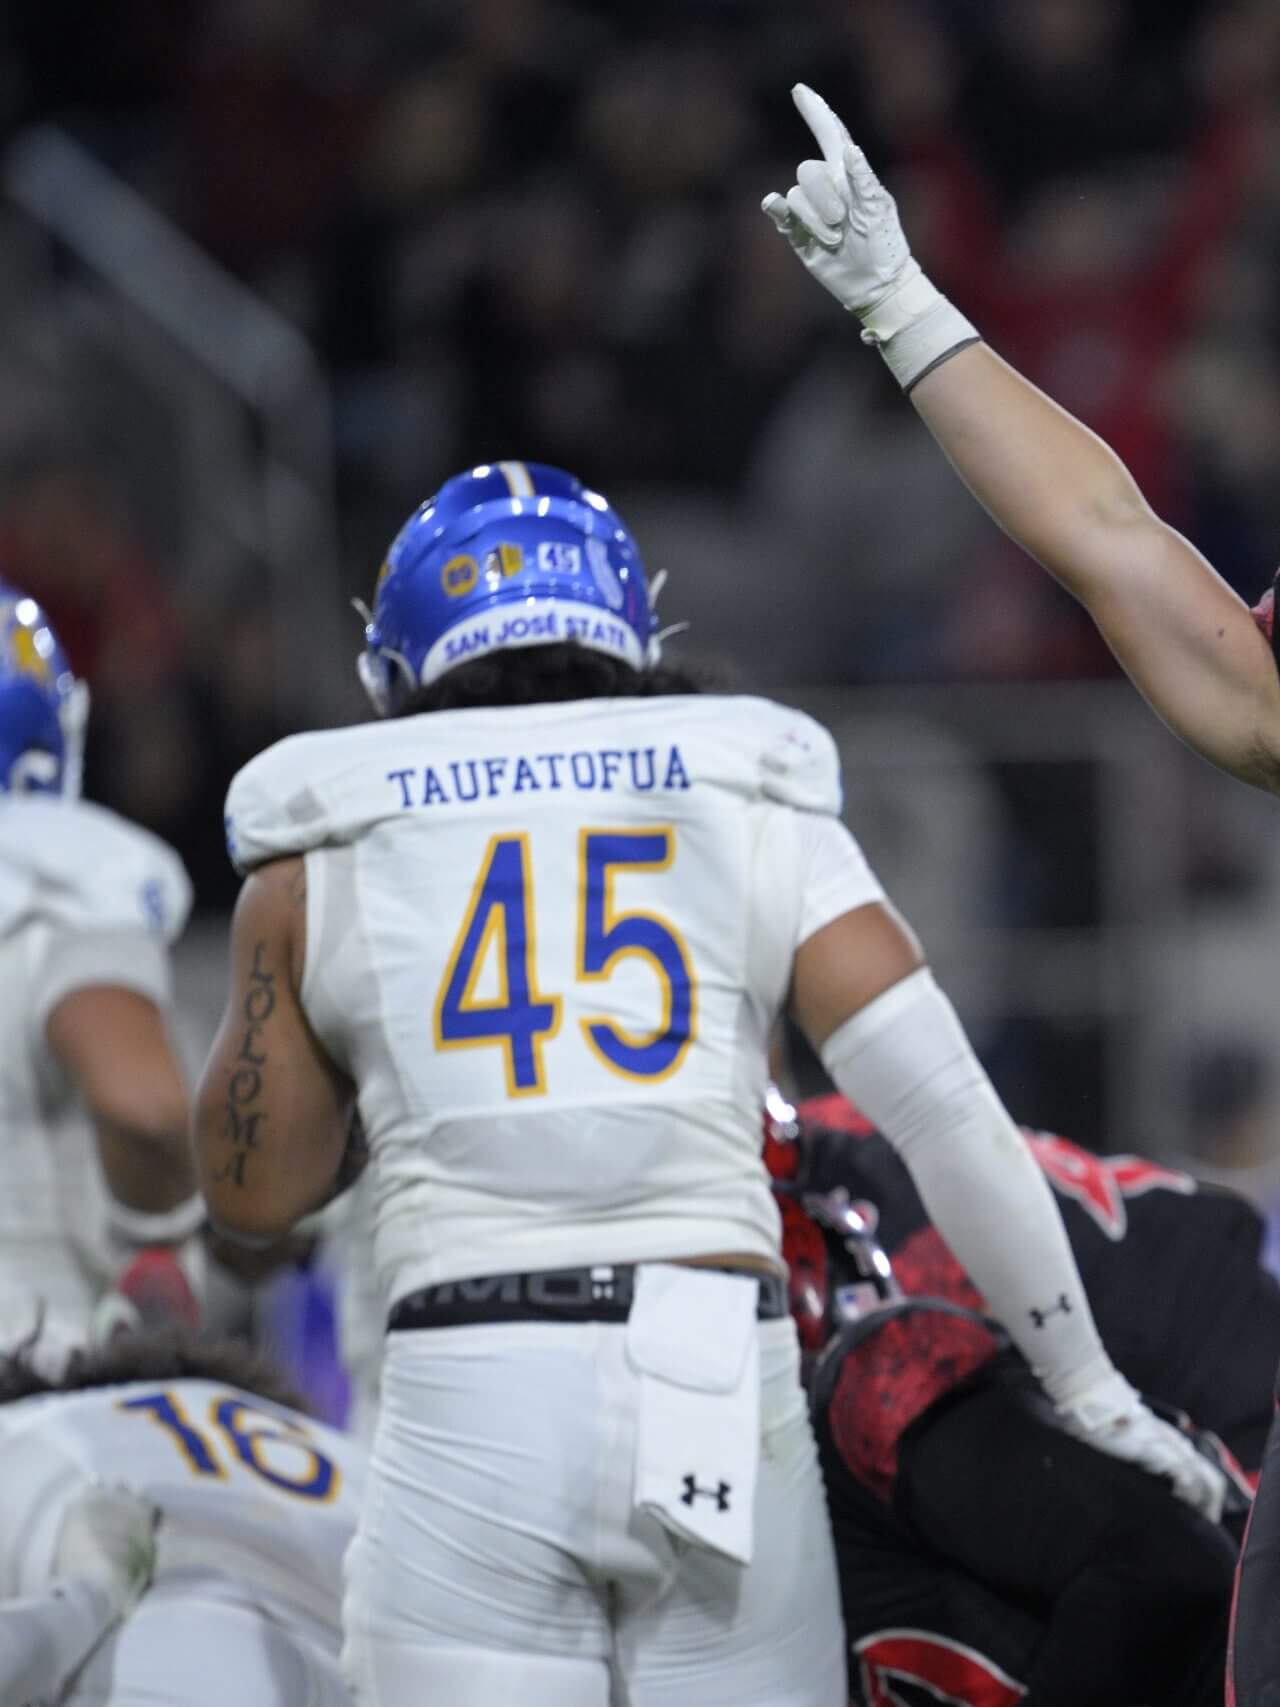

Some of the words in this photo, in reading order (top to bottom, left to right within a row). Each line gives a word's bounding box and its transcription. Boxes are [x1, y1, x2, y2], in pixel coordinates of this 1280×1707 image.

[444, 623, 490, 662] SAN
[495, 611, 559, 643] JOSÉ
[565, 615, 626, 651] STATE
[386, 744, 692, 809] TAUFATOFUA
[433, 825, 699, 1100] 45
[115, 1388, 341, 1504] 16
